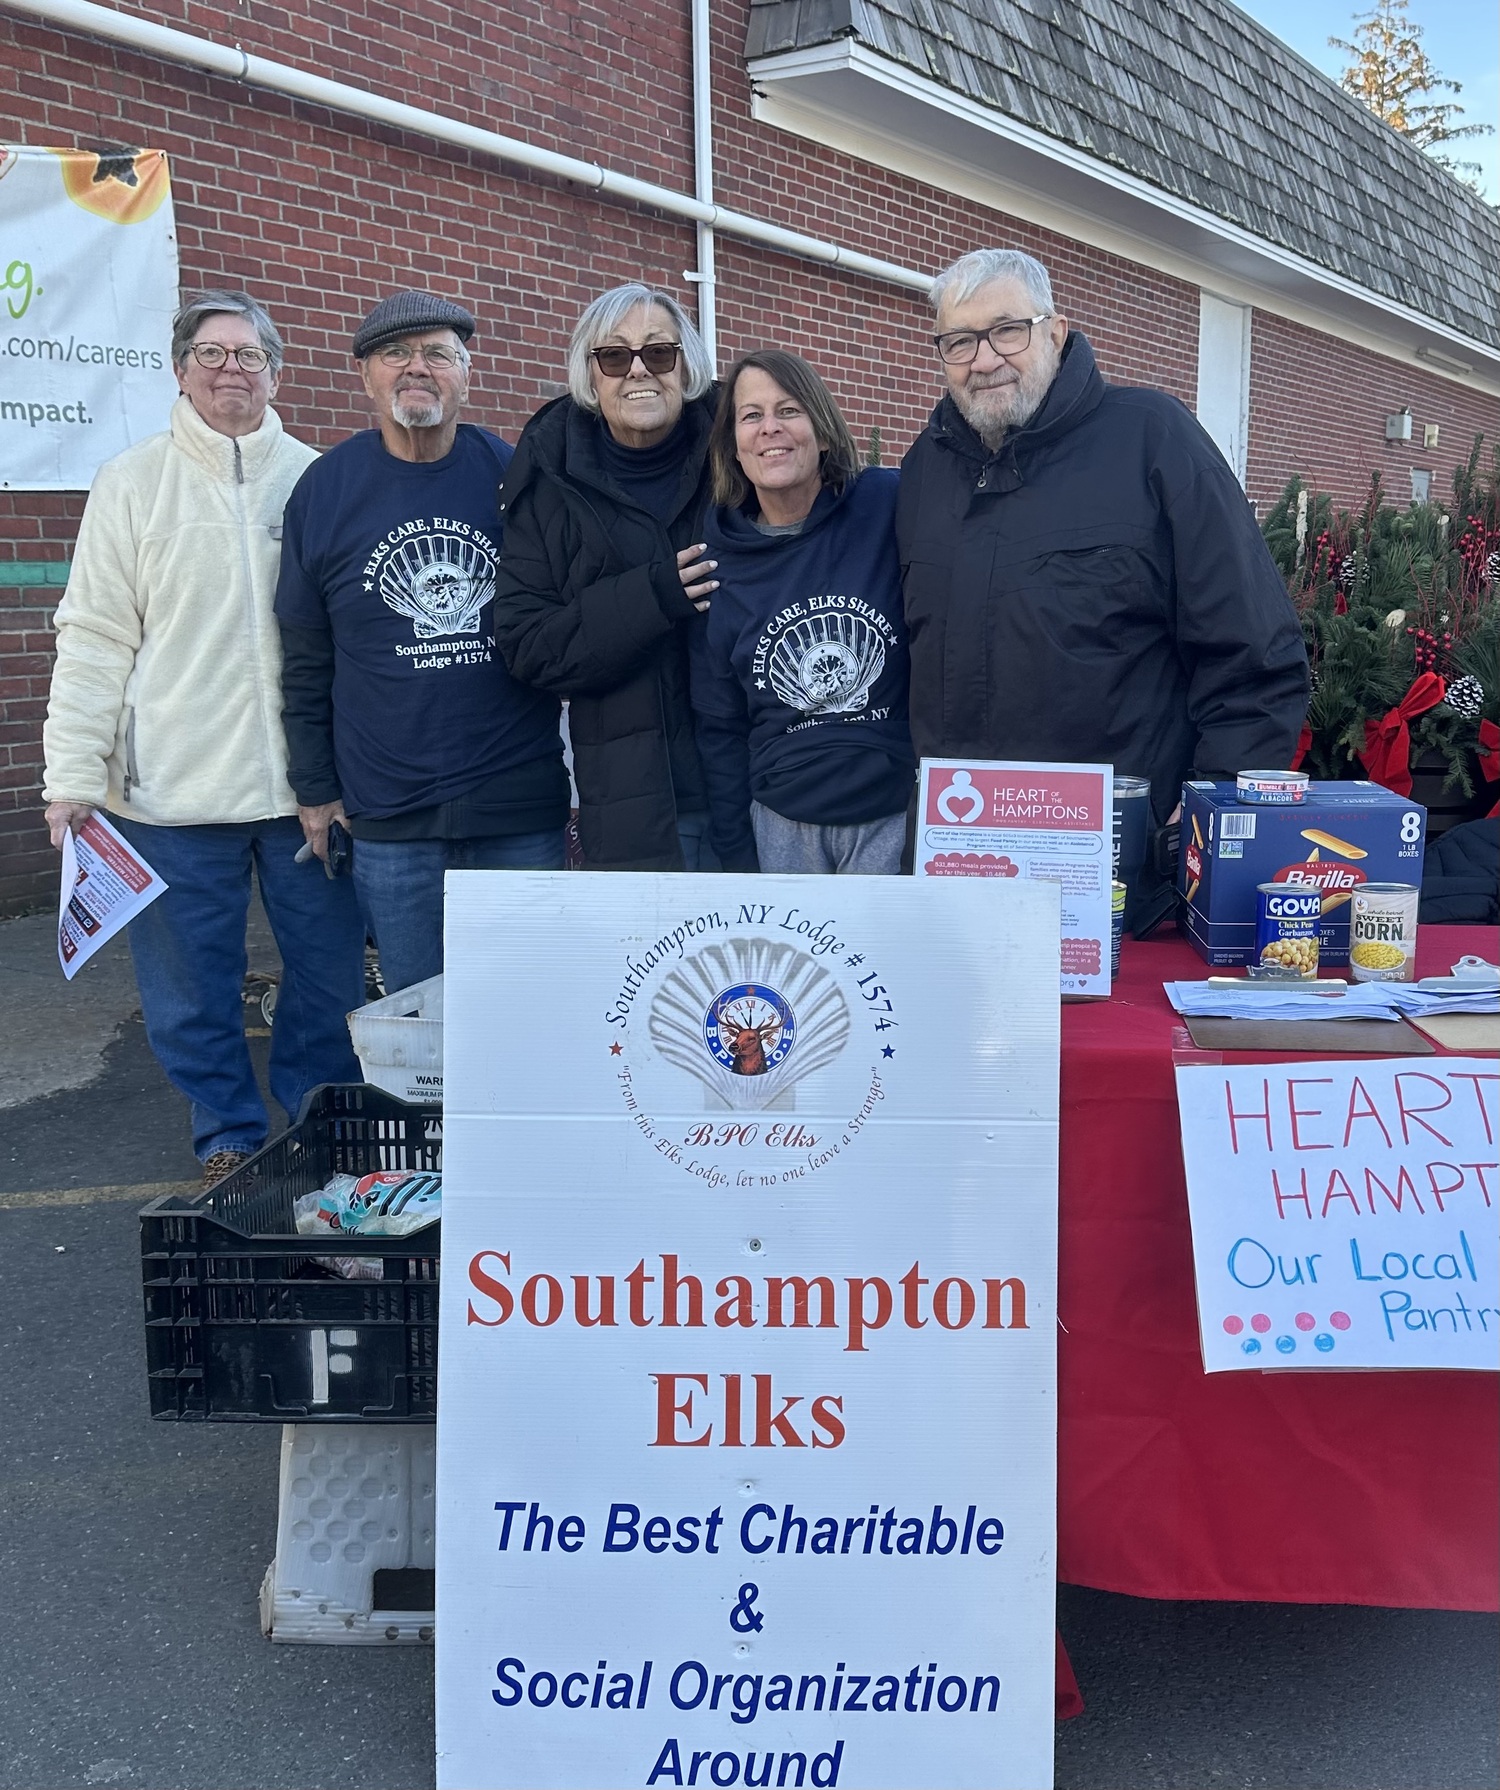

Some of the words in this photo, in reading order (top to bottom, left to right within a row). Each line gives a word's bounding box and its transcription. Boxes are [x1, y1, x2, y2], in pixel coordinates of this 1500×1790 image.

[0, 260, 44, 320] g.
[0, 401, 93, 428] mpact.
[363, 541, 391, 577] ELKS
[387, 518, 431, 544] CARE,
[432, 517, 471, 536] ELKS
[395, 639, 485, 657] Southampton,
[413, 656, 452, 669] Lodge
[455, 651, 492, 664] #1574
[752, 635, 772, 674] ELKS
[766, 602, 808, 635] CARE,
[808, 595, 846, 611] ELKS
[847, 597, 893, 636] SHARE
[871, 707, 891, 721] NY
[993, 803, 1089, 820] HAMPTONS
[994, 787, 1048, 802] HEART
[1400, 811, 1421, 843] 8
[1285, 870, 1355, 888] Barilla
[1269, 897, 1320, 916] GOYA
[1355, 920, 1403, 941] CORN
[1356, 914, 1404, 922] SWEET
[605, 911, 729, 1028] Southampton,
[736, 904, 775, 924] NY
[779, 909, 845, 955] Lodge
[618, 1065, 638, 1111] "From
[634, 1113, 655, 1139] this
[654, 1138, 684, 1165] Elks
[685, 1160, 729, 1189] Lodge,
[736, 1170, 754, 1187] let
[760, 1175, 776, 1186] no
[782, 1166, 805, 1182] one
[808, 1144, 840, 1171] leave
[841, 1134, 851, 1146] a
[848, 1066, 885, 1134] Stranger"
[684, 1122, 760, 1147] BPO
[765, 1123, 822, 1148] Elks
[1226, 1071, 1500, 1155] HEART
[1271, 1161, 1500, 1220] HAMPT
[1227, 1237, 1322, 1289] Our
[1350, 1230, 1478, 1282] Local
[466, 1250, 1030, 1352] Southampton
[1379, 1290, 1500, 1342] Pantr
[647, 1372, 846, 1449] Elks
[493, 1501, 586, 1554] The
[603, 1503, 723, 1555] Best
[739, 1503, 1005, 1556] Charitable
[729, 1582, 764, 1633] &
[491, 1657, 654, 1710] Social
[669, 1660, 1001, 1724] Organization
[646, 1738, 845, 1789] Around
